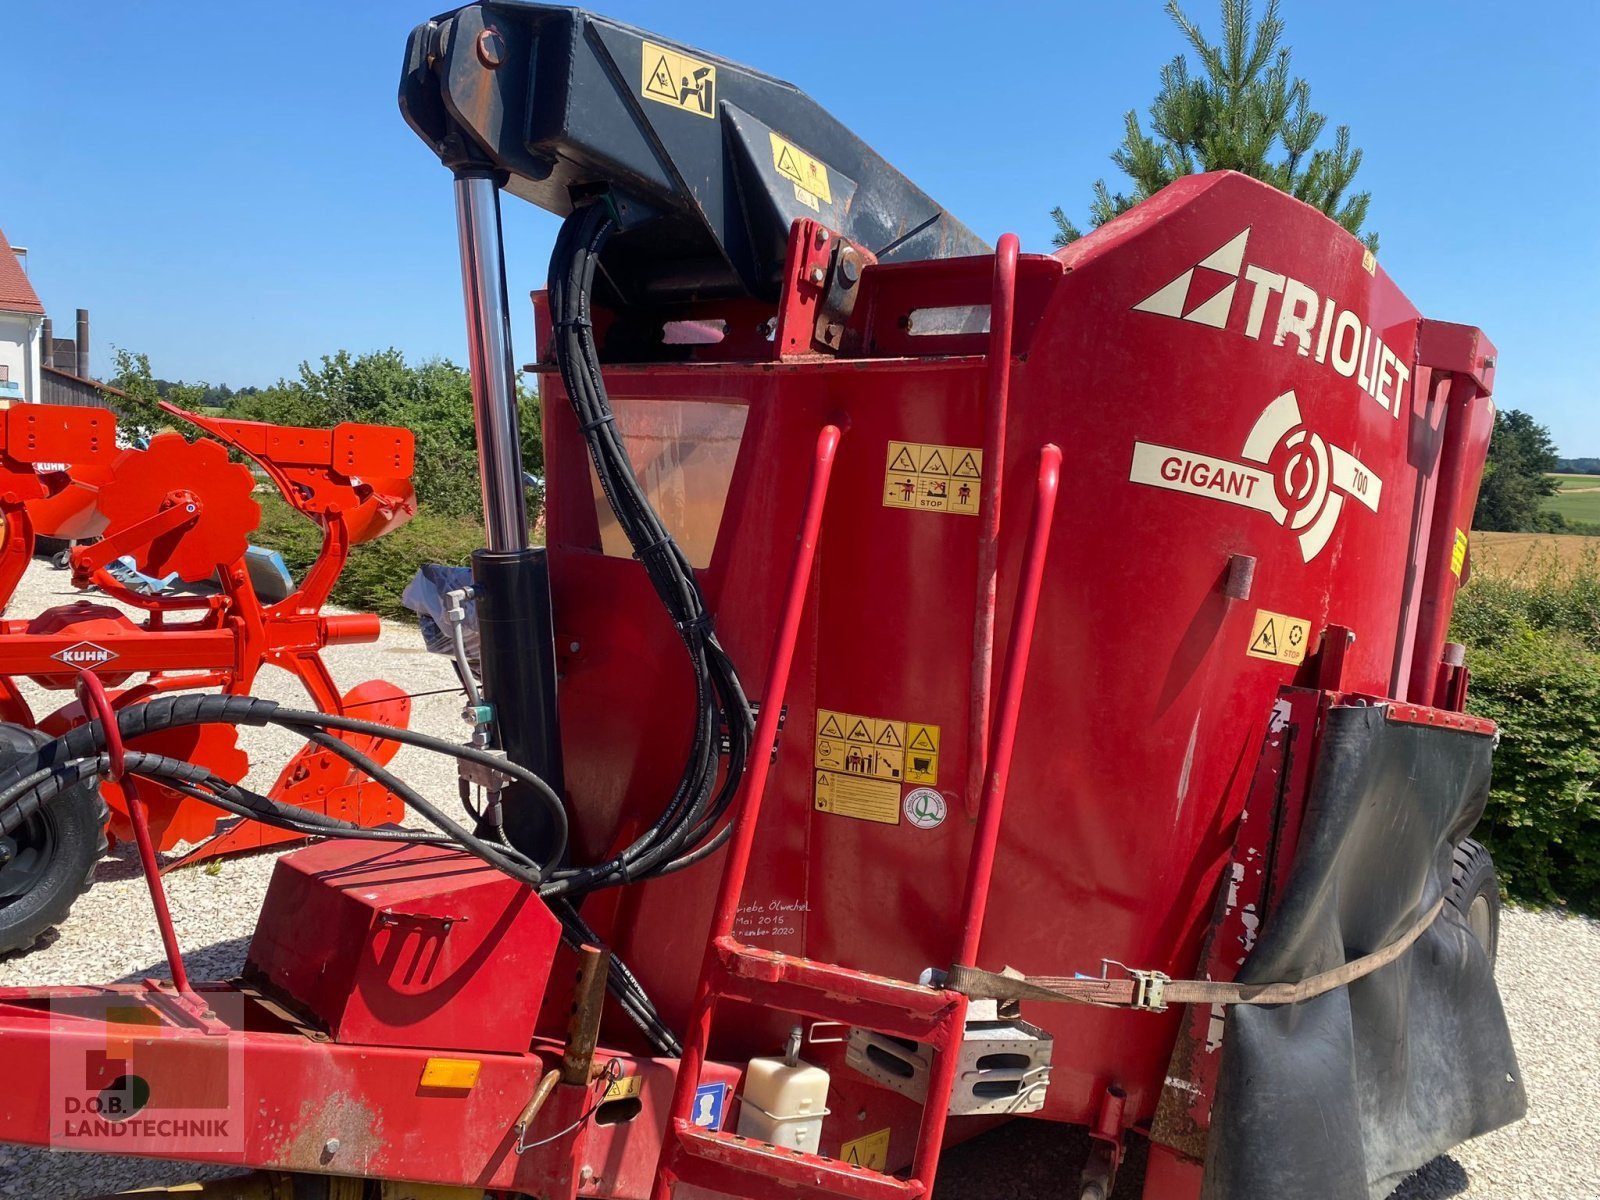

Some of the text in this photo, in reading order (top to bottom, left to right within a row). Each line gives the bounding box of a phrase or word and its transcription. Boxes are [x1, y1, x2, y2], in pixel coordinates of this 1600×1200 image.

[1244, 264, 1410, 420] TRIOLIET
[37, 462, 65, 471] KUHN
[1160, 456, 1260, 499] GIGANT
[1352, 467, 1368, 496] 700
[920, 499, 942, 507] STOP
[63, 651, 108, 661] KUHN
[1284, 649, 1300, 659] STOP
[736, 899, 812, 913] riebe Ölwechsel
[758, 916, 784, 925] 2015
[771, 927, 795, 936] 2020
